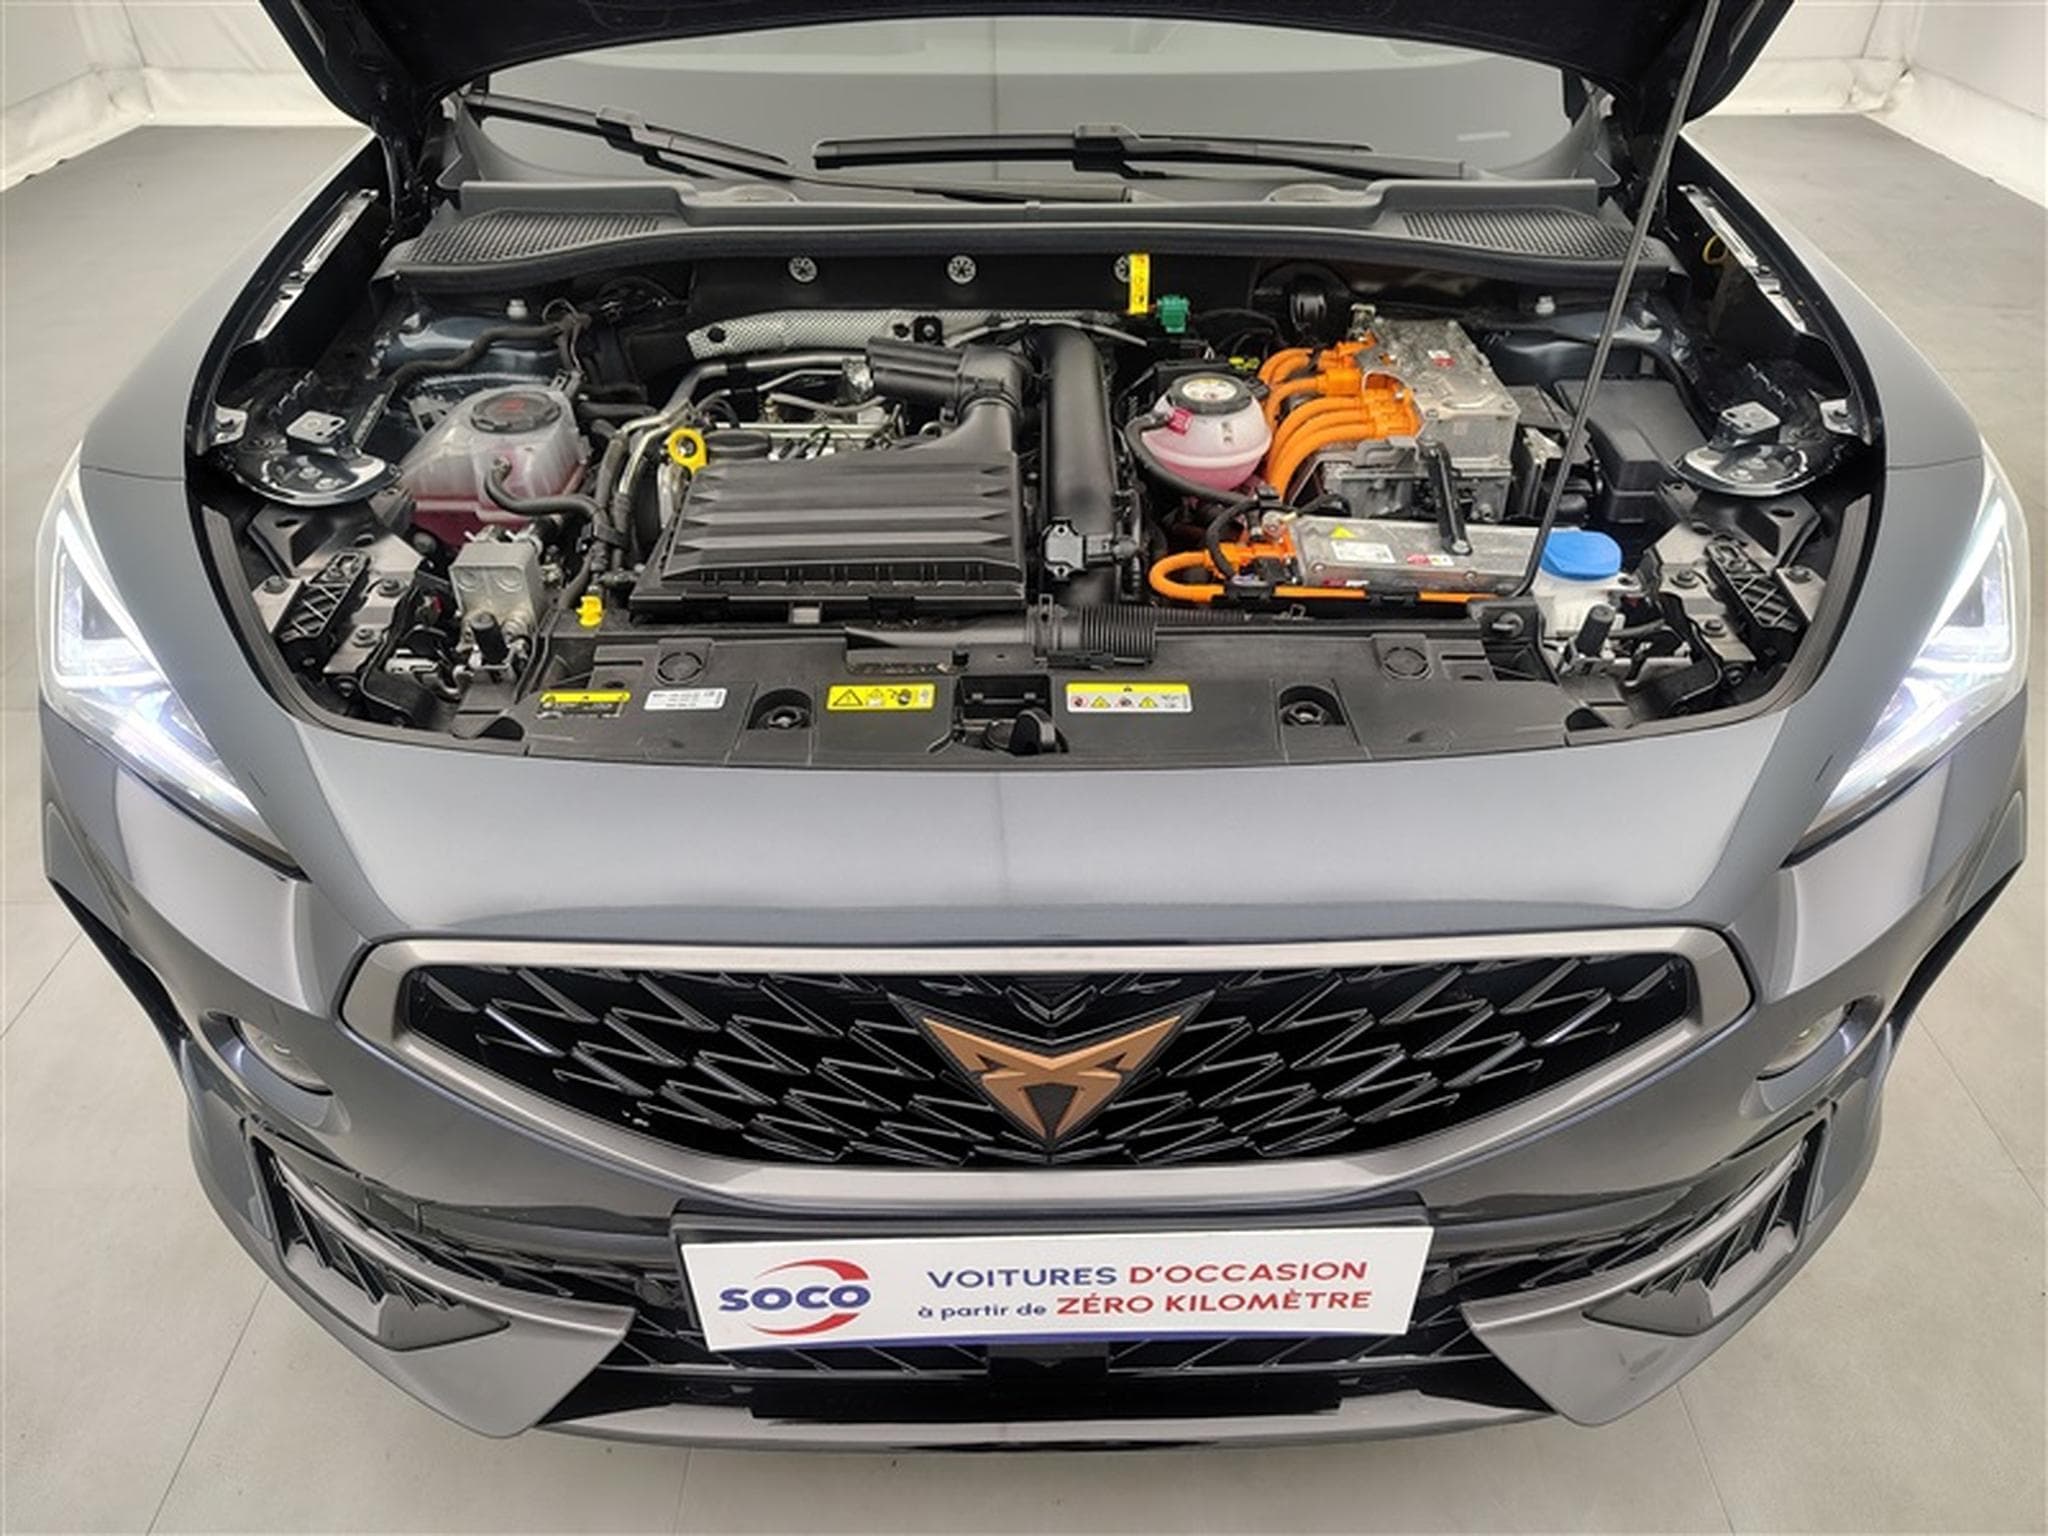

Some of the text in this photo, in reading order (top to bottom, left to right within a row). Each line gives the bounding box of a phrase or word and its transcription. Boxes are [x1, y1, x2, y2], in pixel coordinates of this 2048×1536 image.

[927, 1261, 1368, 1288] VOITURES D'OCCASION
[719, 1285, 871, 1311] SOCO
[917, 1288, 1373, 1321] à partir de ZÉRO KILOMÈTRE
